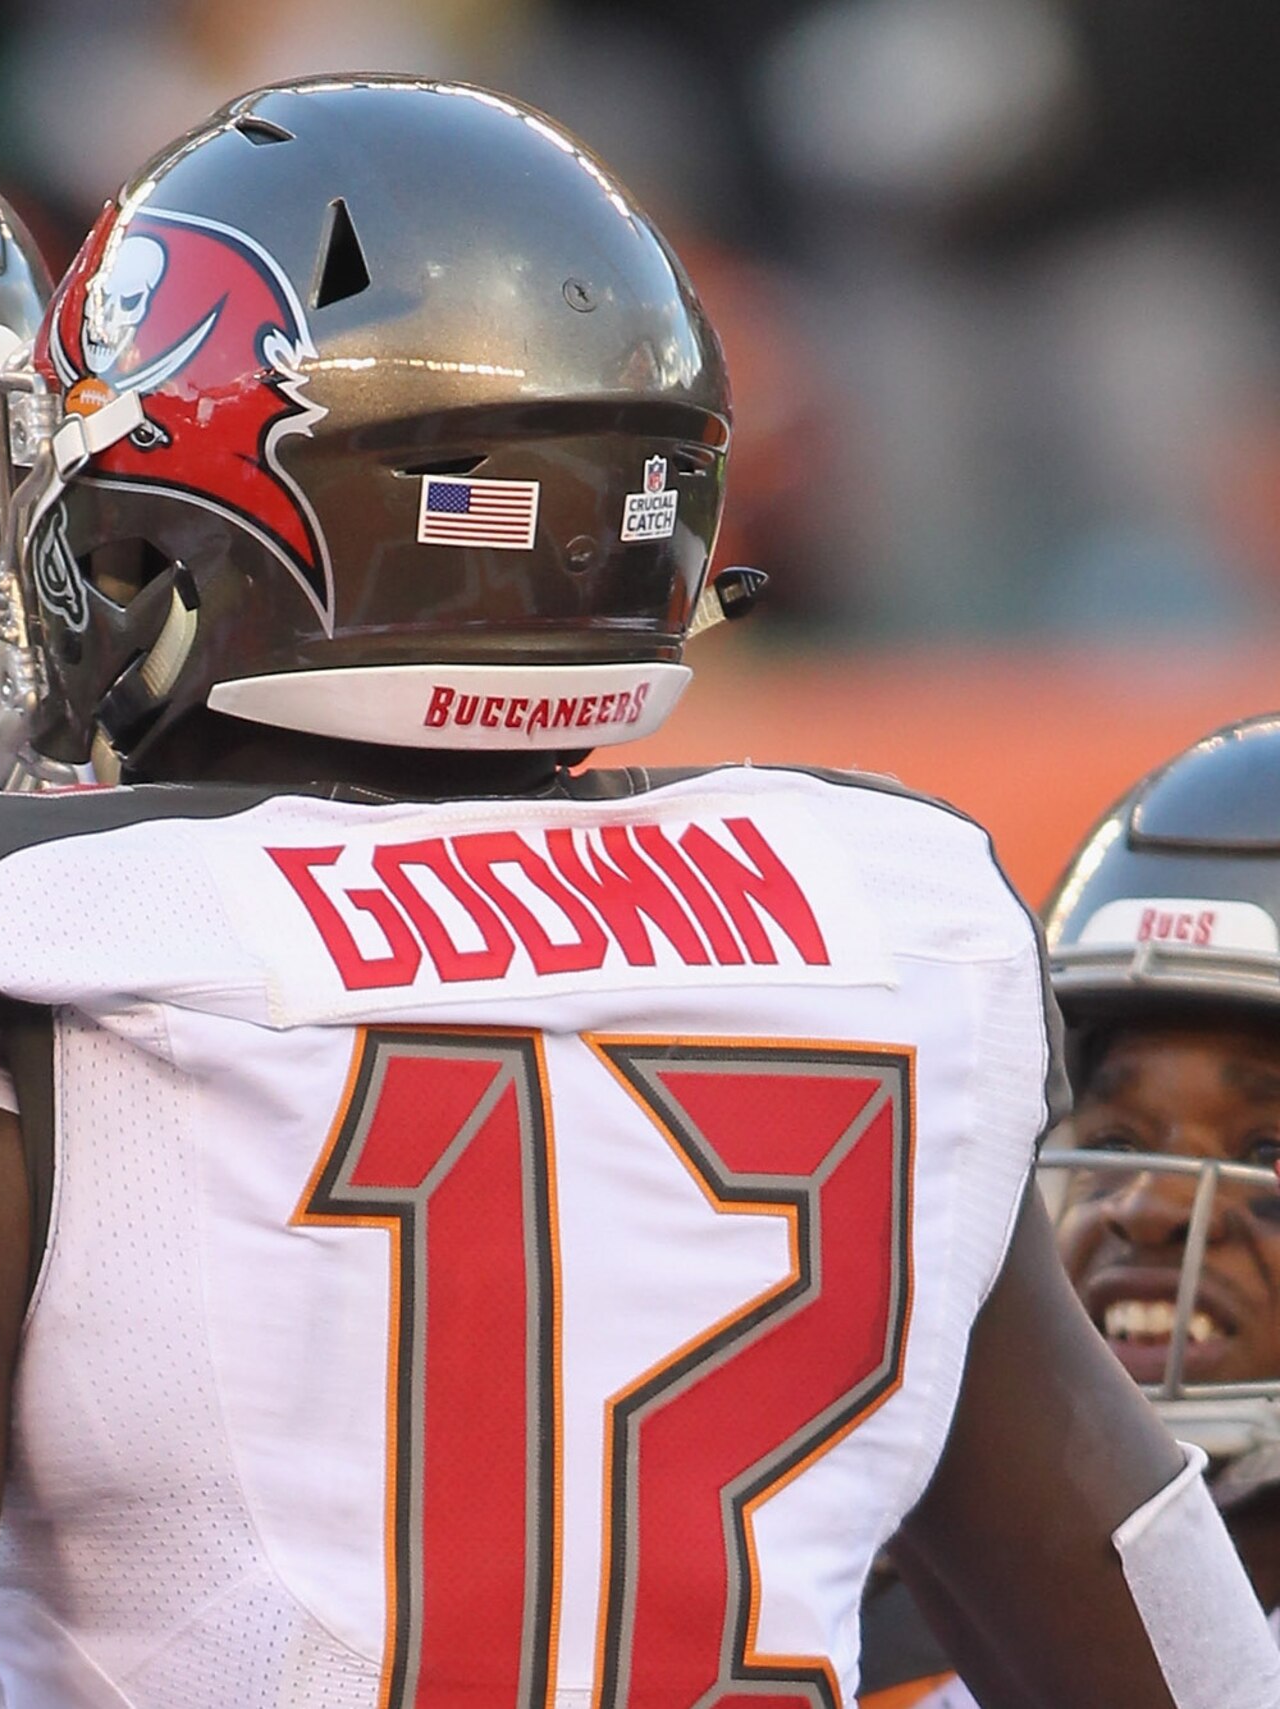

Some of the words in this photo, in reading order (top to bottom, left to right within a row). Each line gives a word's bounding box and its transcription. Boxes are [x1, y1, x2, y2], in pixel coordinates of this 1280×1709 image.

[627, 512, 672, 532] CATCH
[629, 496, 674, 512] CRUCIAL
[424, 682, 650, 736] BUCCANEERS
[263, 817, 830, 990] GODWIN
[285, 1024, 917, 1709] 12
